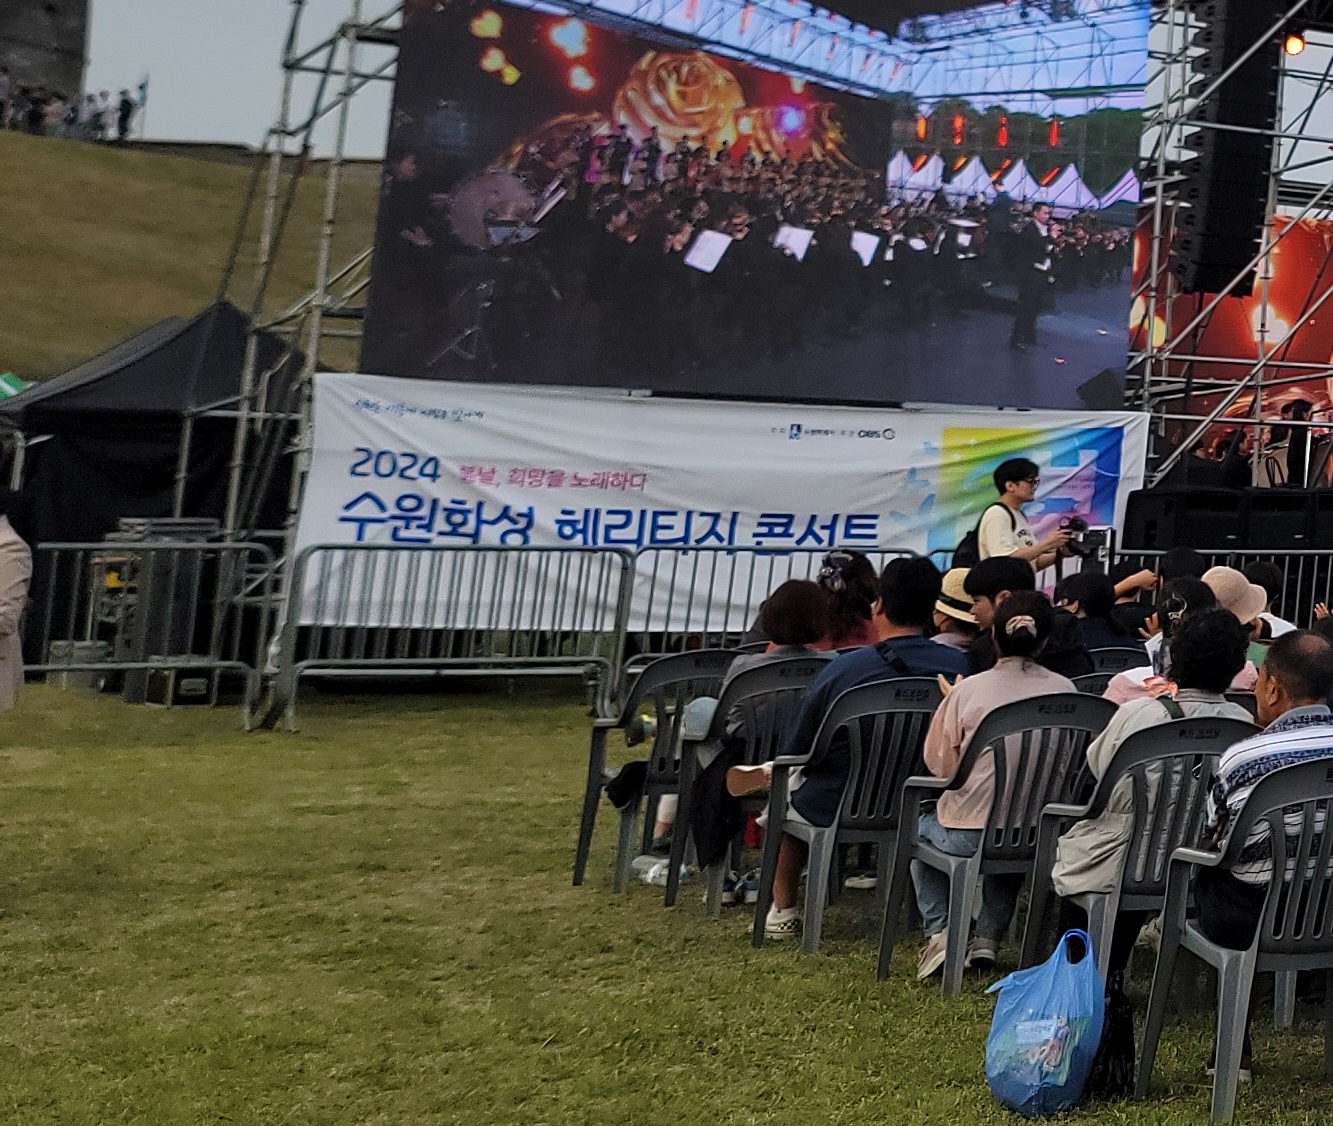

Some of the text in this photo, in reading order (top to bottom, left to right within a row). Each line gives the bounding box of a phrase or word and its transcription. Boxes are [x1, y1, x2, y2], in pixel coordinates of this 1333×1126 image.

[350, 447, 441, 483] 2024
[508, 466, 566, 489] 희망을
[570, 469, 648, 492] 노래하다
[338, 490, 881, 556] 수원화성 헤리티지 콘서트
